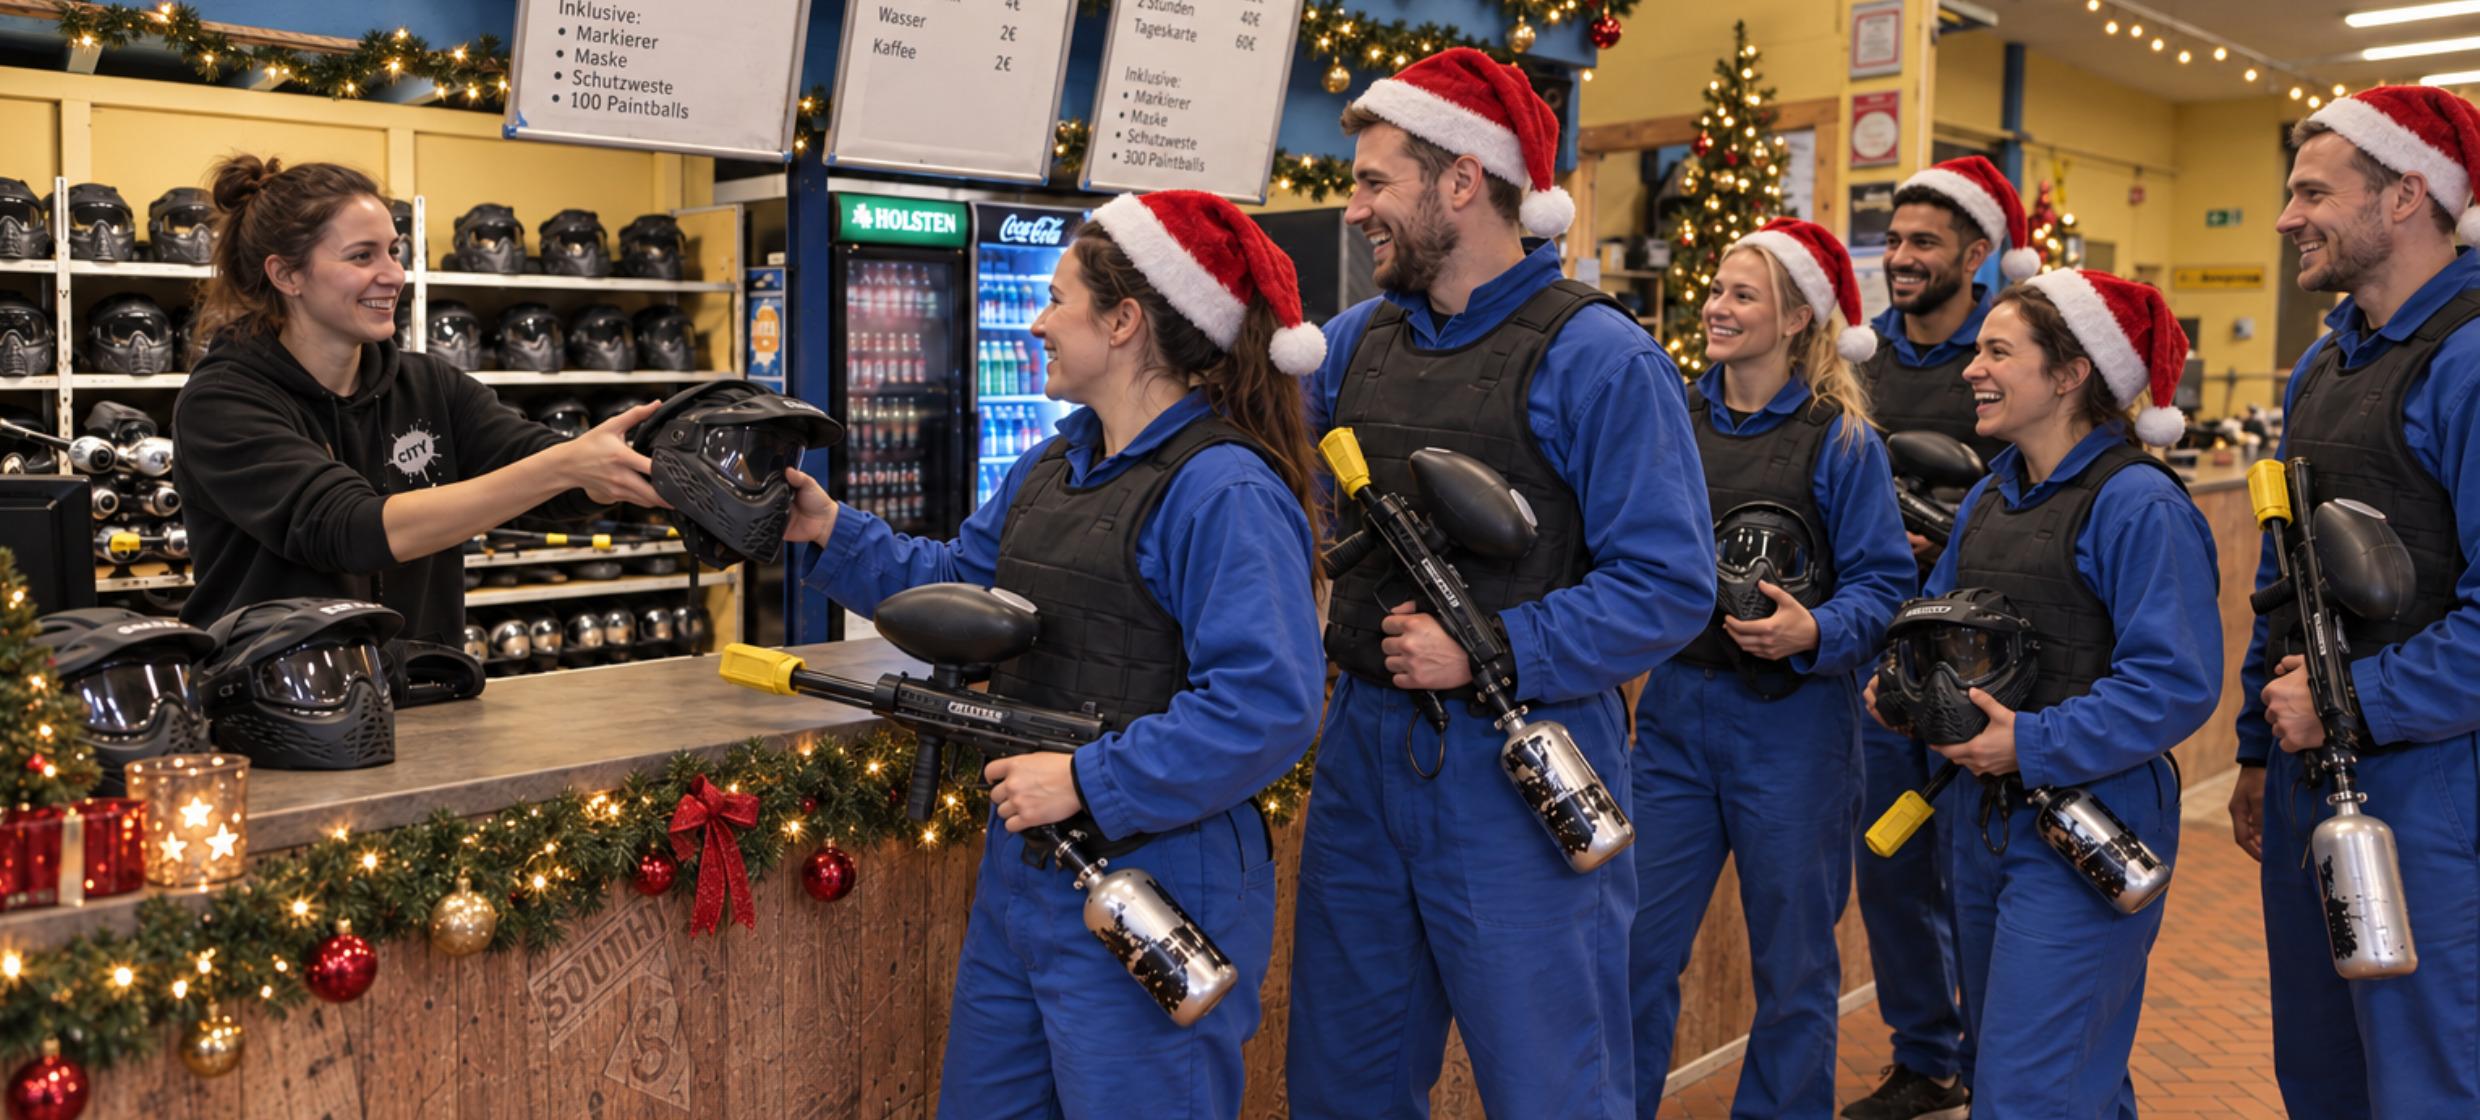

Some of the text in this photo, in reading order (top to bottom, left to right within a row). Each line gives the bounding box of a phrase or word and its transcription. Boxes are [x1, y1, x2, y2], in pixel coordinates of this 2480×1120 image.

[559, 0, 641, 24] Inklusive:
[878, 6, 1018, 42] Wasser 2€
[1241, 10, 1262, 27] 40€
[576, 25, 659, 49] Markierer
[1135, 18, 1257, 51] Tageskarte 60€
[574, 47, 628, 68] Maske
[872, 38, 1013, 72] Kaffee 2€
[571, 69, 673, 95] Schutzweste
[1125, 66, 1182, 89] Inklusive:
[571, 91, 689, 119] 100 Paintballs
[1133, 89, 1191, 110] Markierer
[1130, 108, 1168, 127] Maske
[1127, 128, 1198, 150] Schutzweste
[1123, 149, 1205, 173] 300 Paintballs
[875, 207, 957, 234] HOLSTEN
[398, 439, 427, 463] CITY
